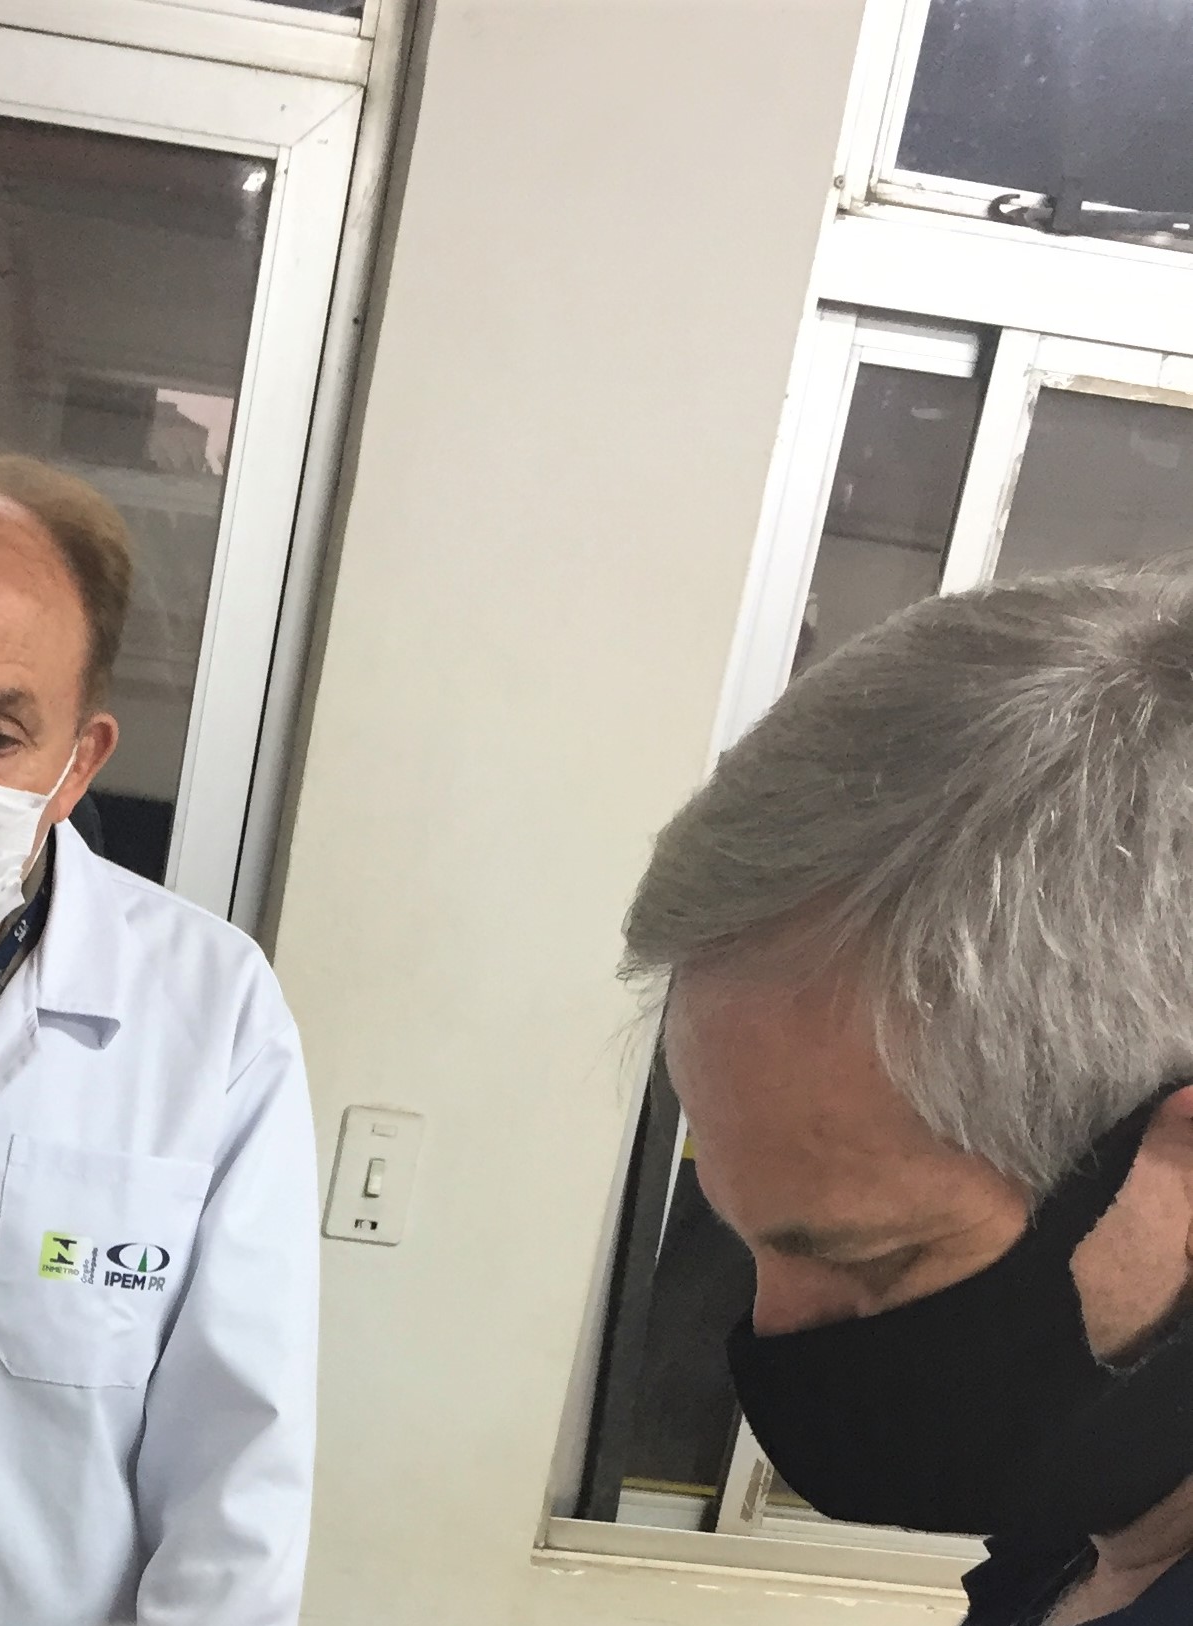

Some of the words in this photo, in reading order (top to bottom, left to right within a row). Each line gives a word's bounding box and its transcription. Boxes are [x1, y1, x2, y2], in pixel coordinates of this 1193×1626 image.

[41, 1264, 80, 1276] INMETRO
[104, 1270, 146, 1291] IPEM
[147, 1276, 166, 1292] PR
